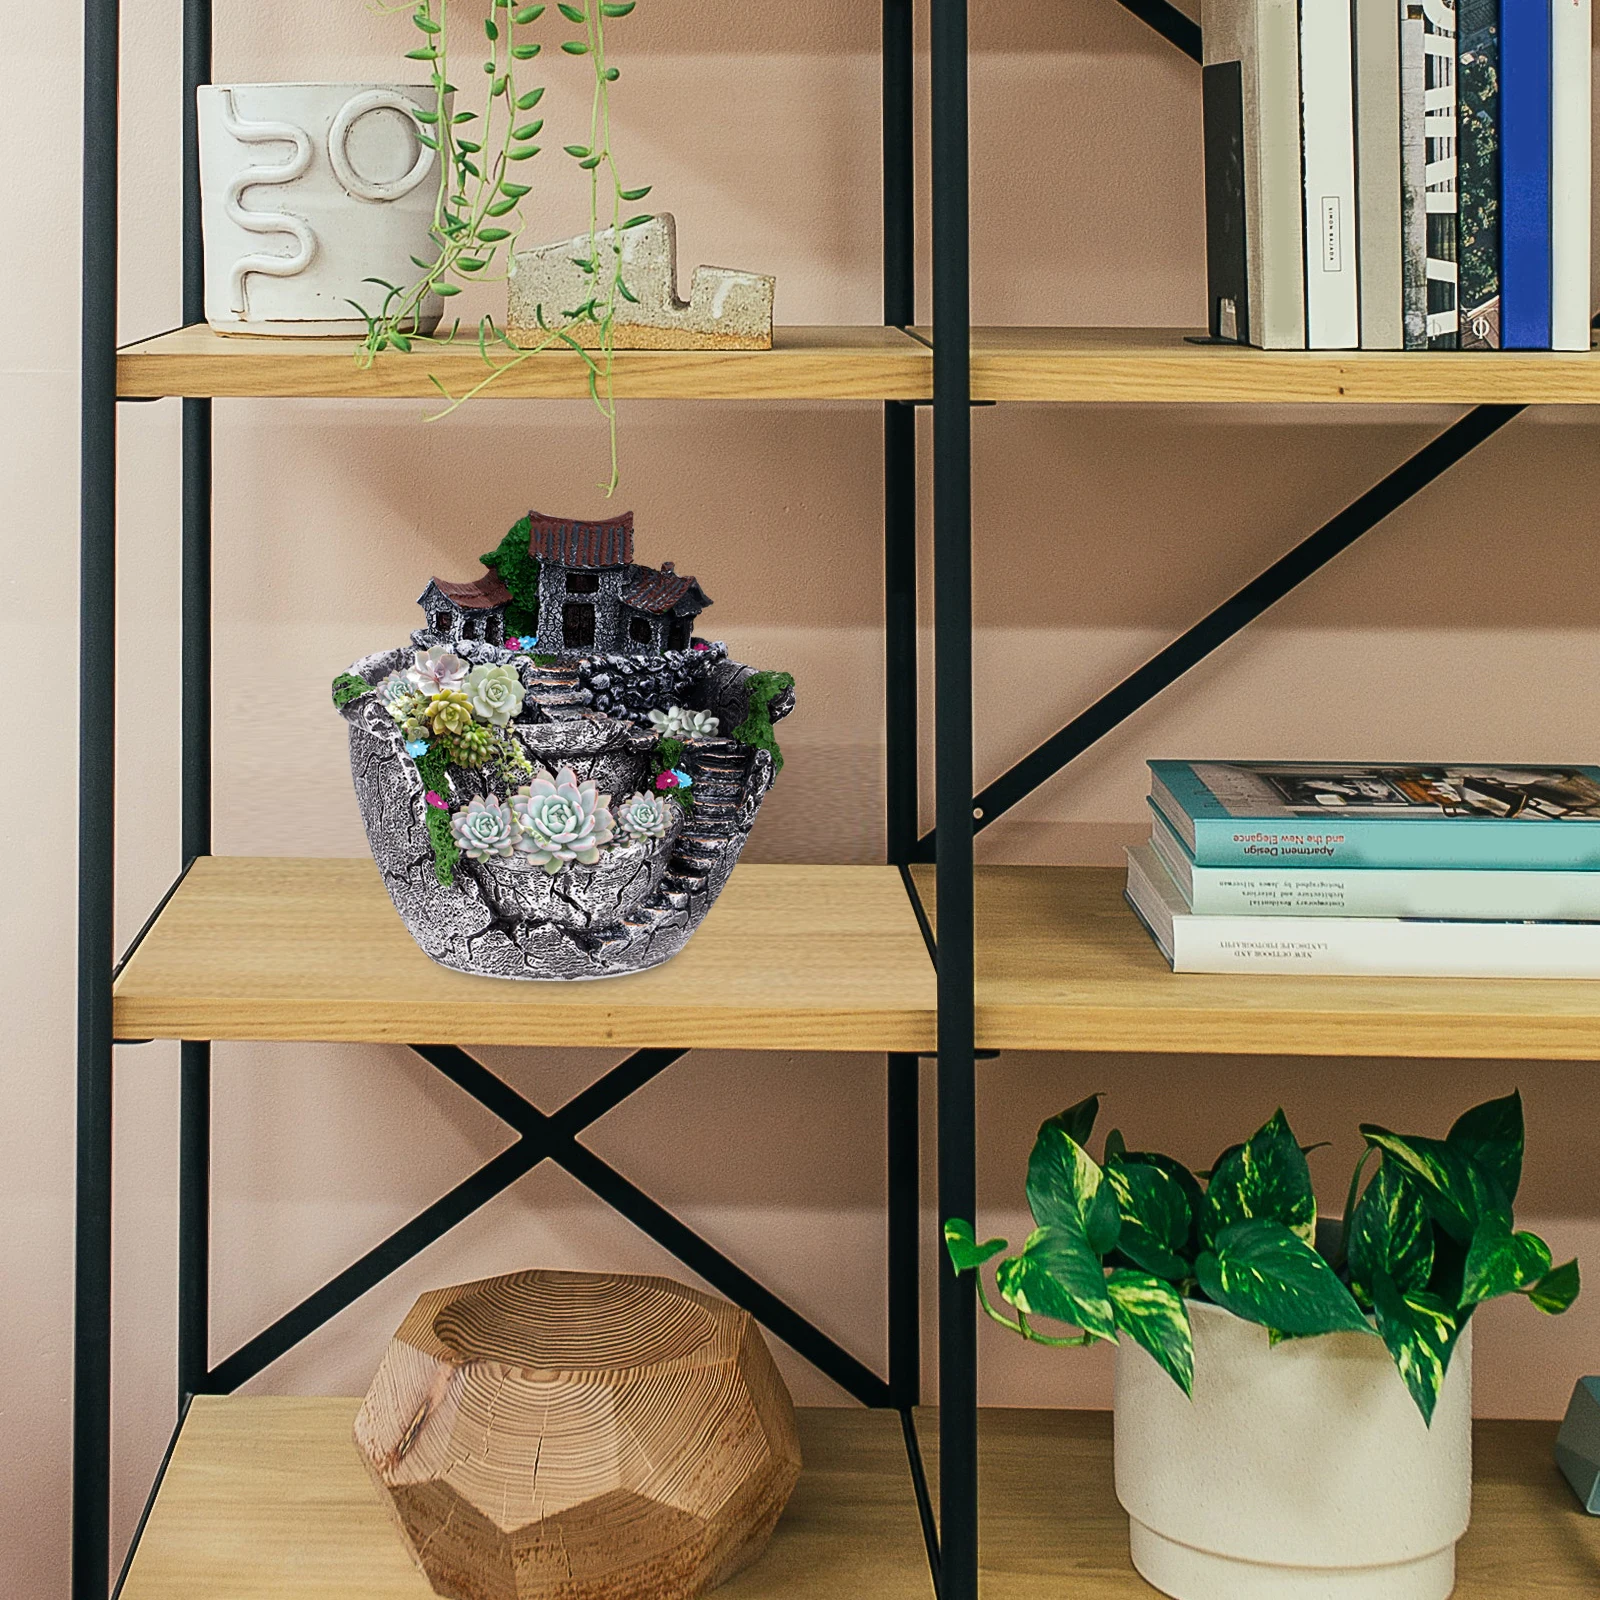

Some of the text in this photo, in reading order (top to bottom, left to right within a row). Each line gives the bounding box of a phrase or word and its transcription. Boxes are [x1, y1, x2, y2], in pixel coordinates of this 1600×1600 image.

[1233, 833, 1345, 845] and the New Elegance
[1243, 845, 1334, 857] Apartment Design
[1283, 881, 1292, 889] by
[1296, 881, 1344, 890] Photographed
[1297, 891, 1345, 899] Architecture
[1295, 899, 1345, 907] Contemporary
[1219, 941, 1328, 951] LANDSCAPE PHOTOGRAPHY
[1294, 951, 1312, 959] NEW
